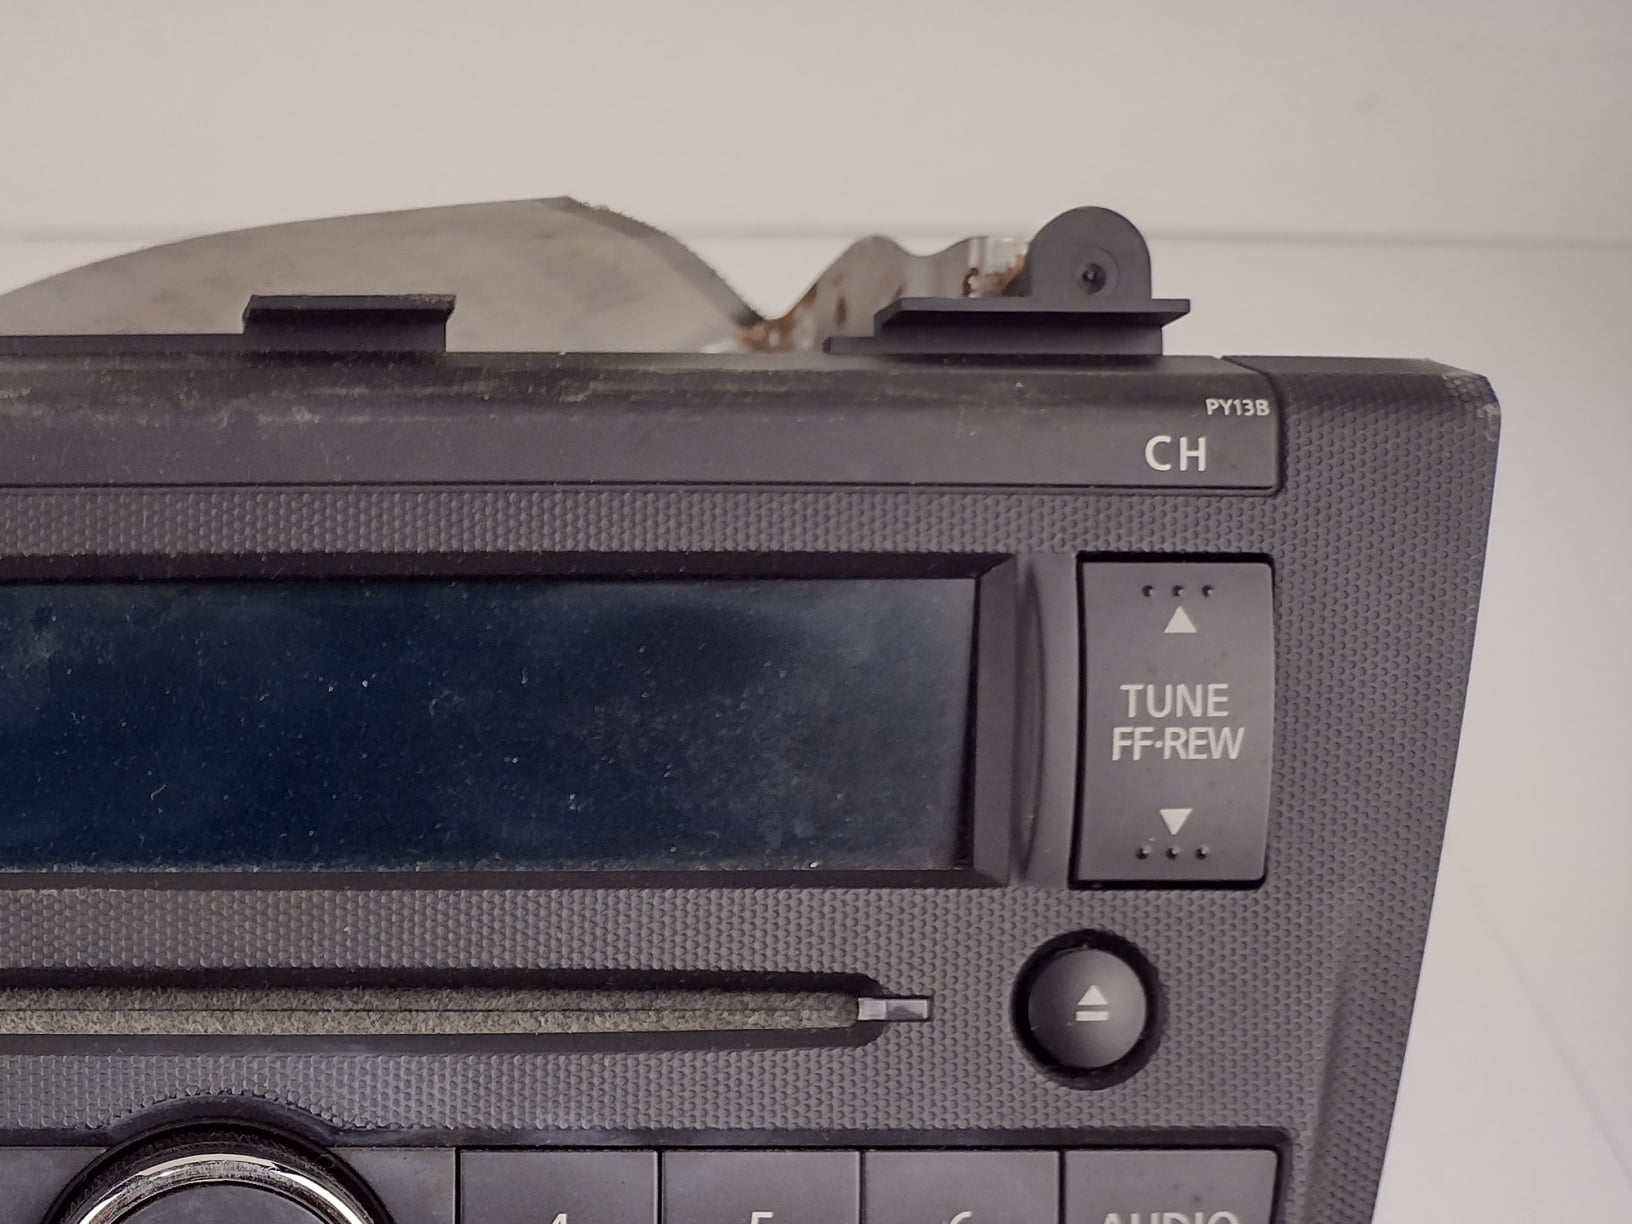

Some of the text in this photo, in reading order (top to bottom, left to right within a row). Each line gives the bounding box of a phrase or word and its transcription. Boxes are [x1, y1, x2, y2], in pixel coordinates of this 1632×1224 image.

[1206, 398, 1269, 416] PY13B
[1145, 436, 1207, 472] CH
[1120, 684, 1229, 718] TUNE
